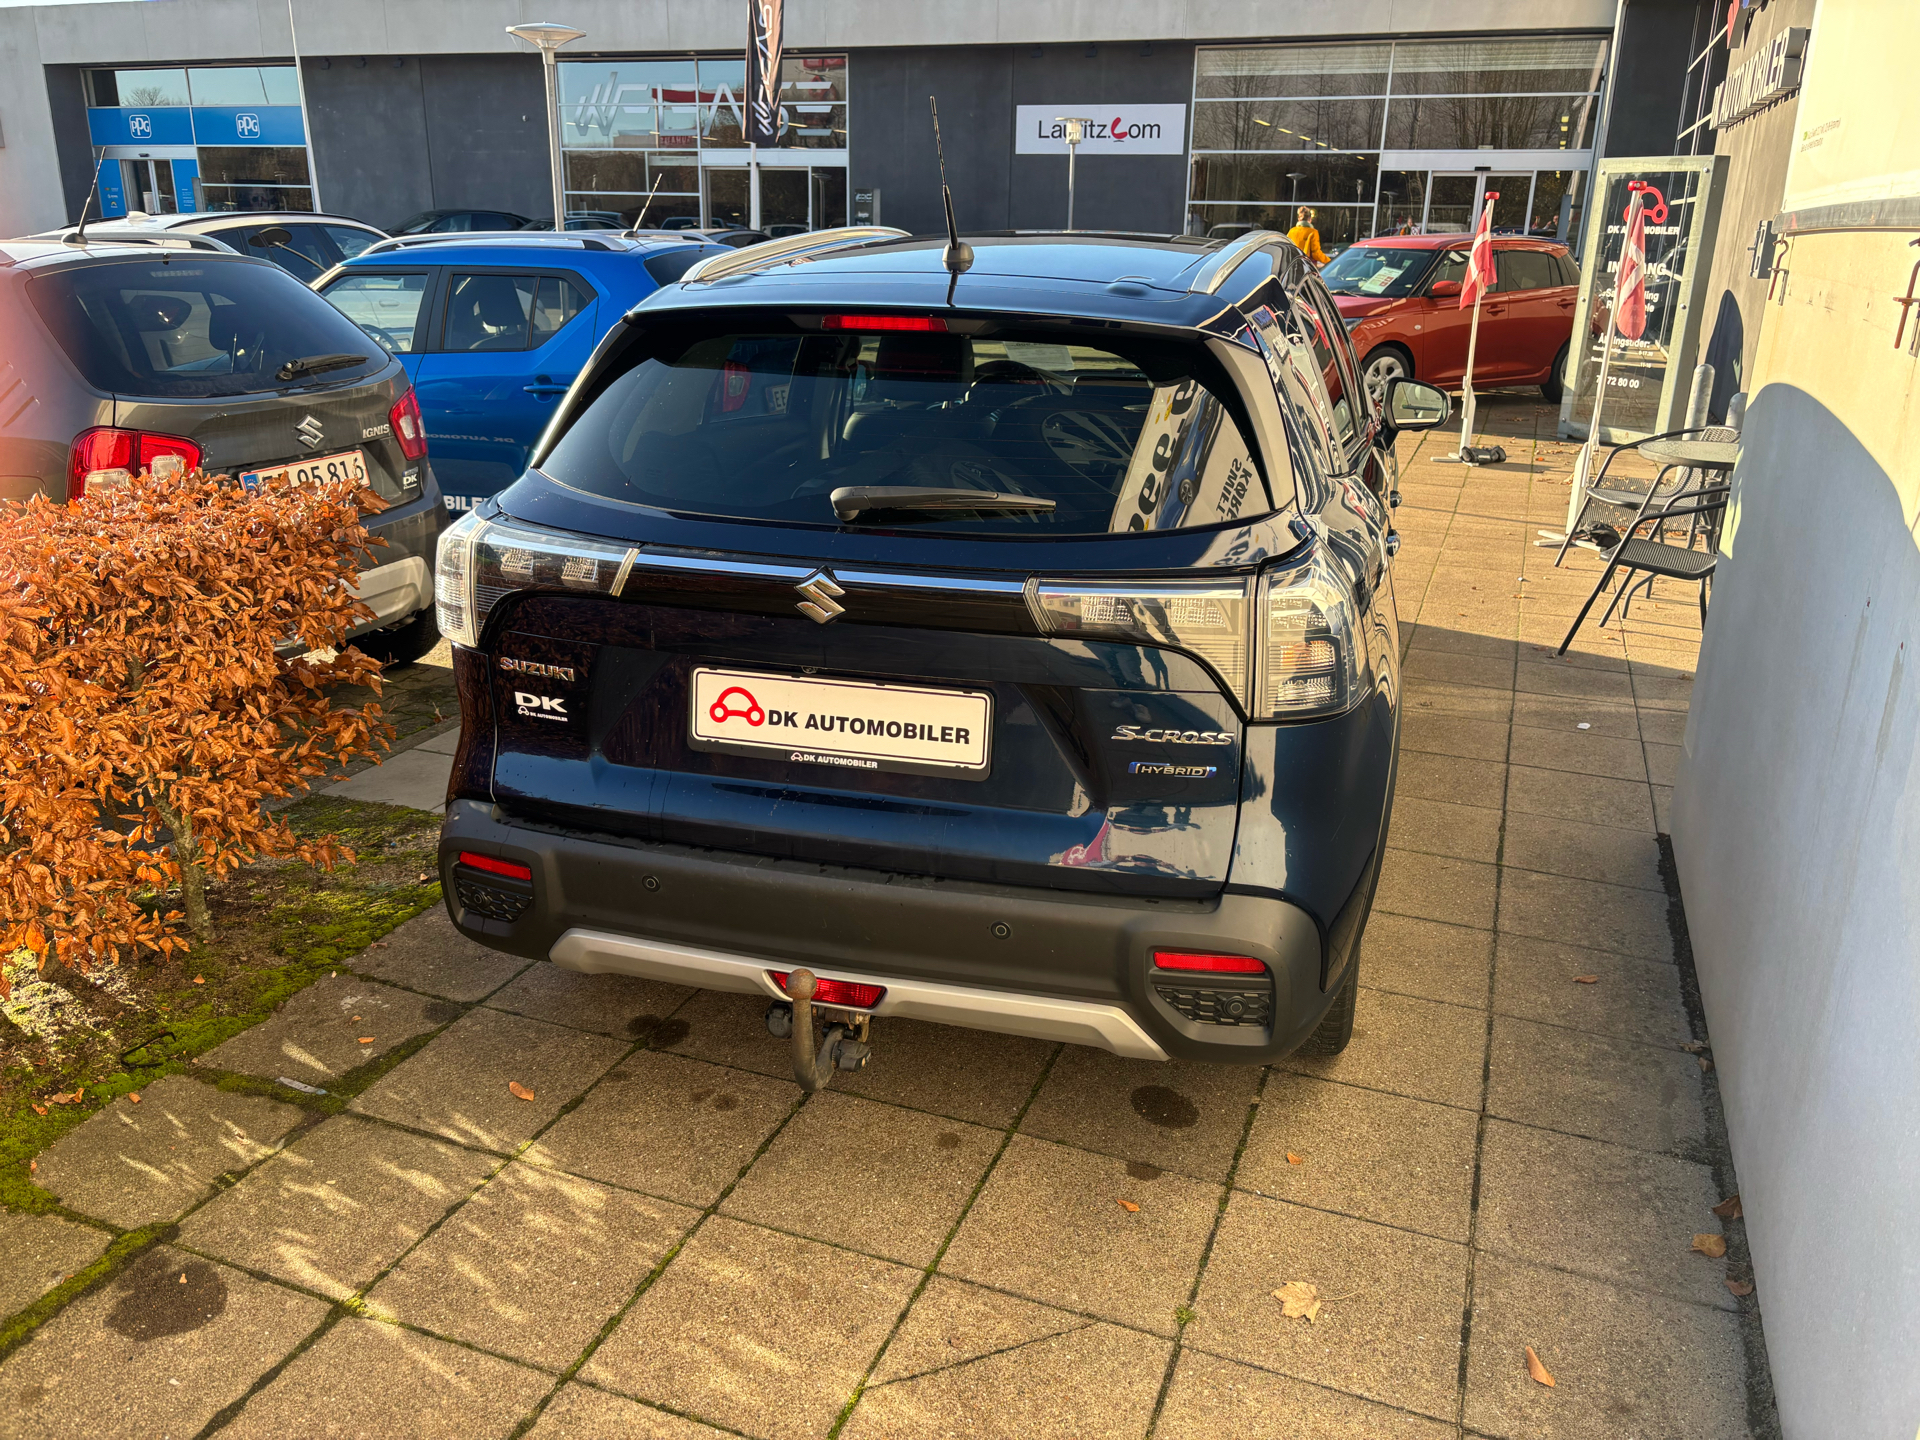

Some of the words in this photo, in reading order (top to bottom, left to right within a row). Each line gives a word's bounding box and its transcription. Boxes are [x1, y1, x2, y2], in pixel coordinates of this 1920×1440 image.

[130, 116, 150, 136] PPG
[237, 116, 258, 136] PPG
[1607, 225, 1620, 234] DK
[1607, 376, 1617, 386] 72
[1618, 377, 1628, 388] 80
[1629, 379, 1640, 389] 00
[362, 424, 390, 439] IGNIS
[403, 473, 418, 485] DK
[500, 656, 575, 681] SUZUKI
[514, 691, 568, 714] DK
[768, 709, 799, 728] DK
[804, 713, 971, 745] AUTOMOBILER
[1111, 725, 1235, 746] S-CROSS
[803, 754, 816, 763] DK
[817, 755, 879, 769] AUTOMOBILER
[1140, 765, 1205, 776] HYBRID
